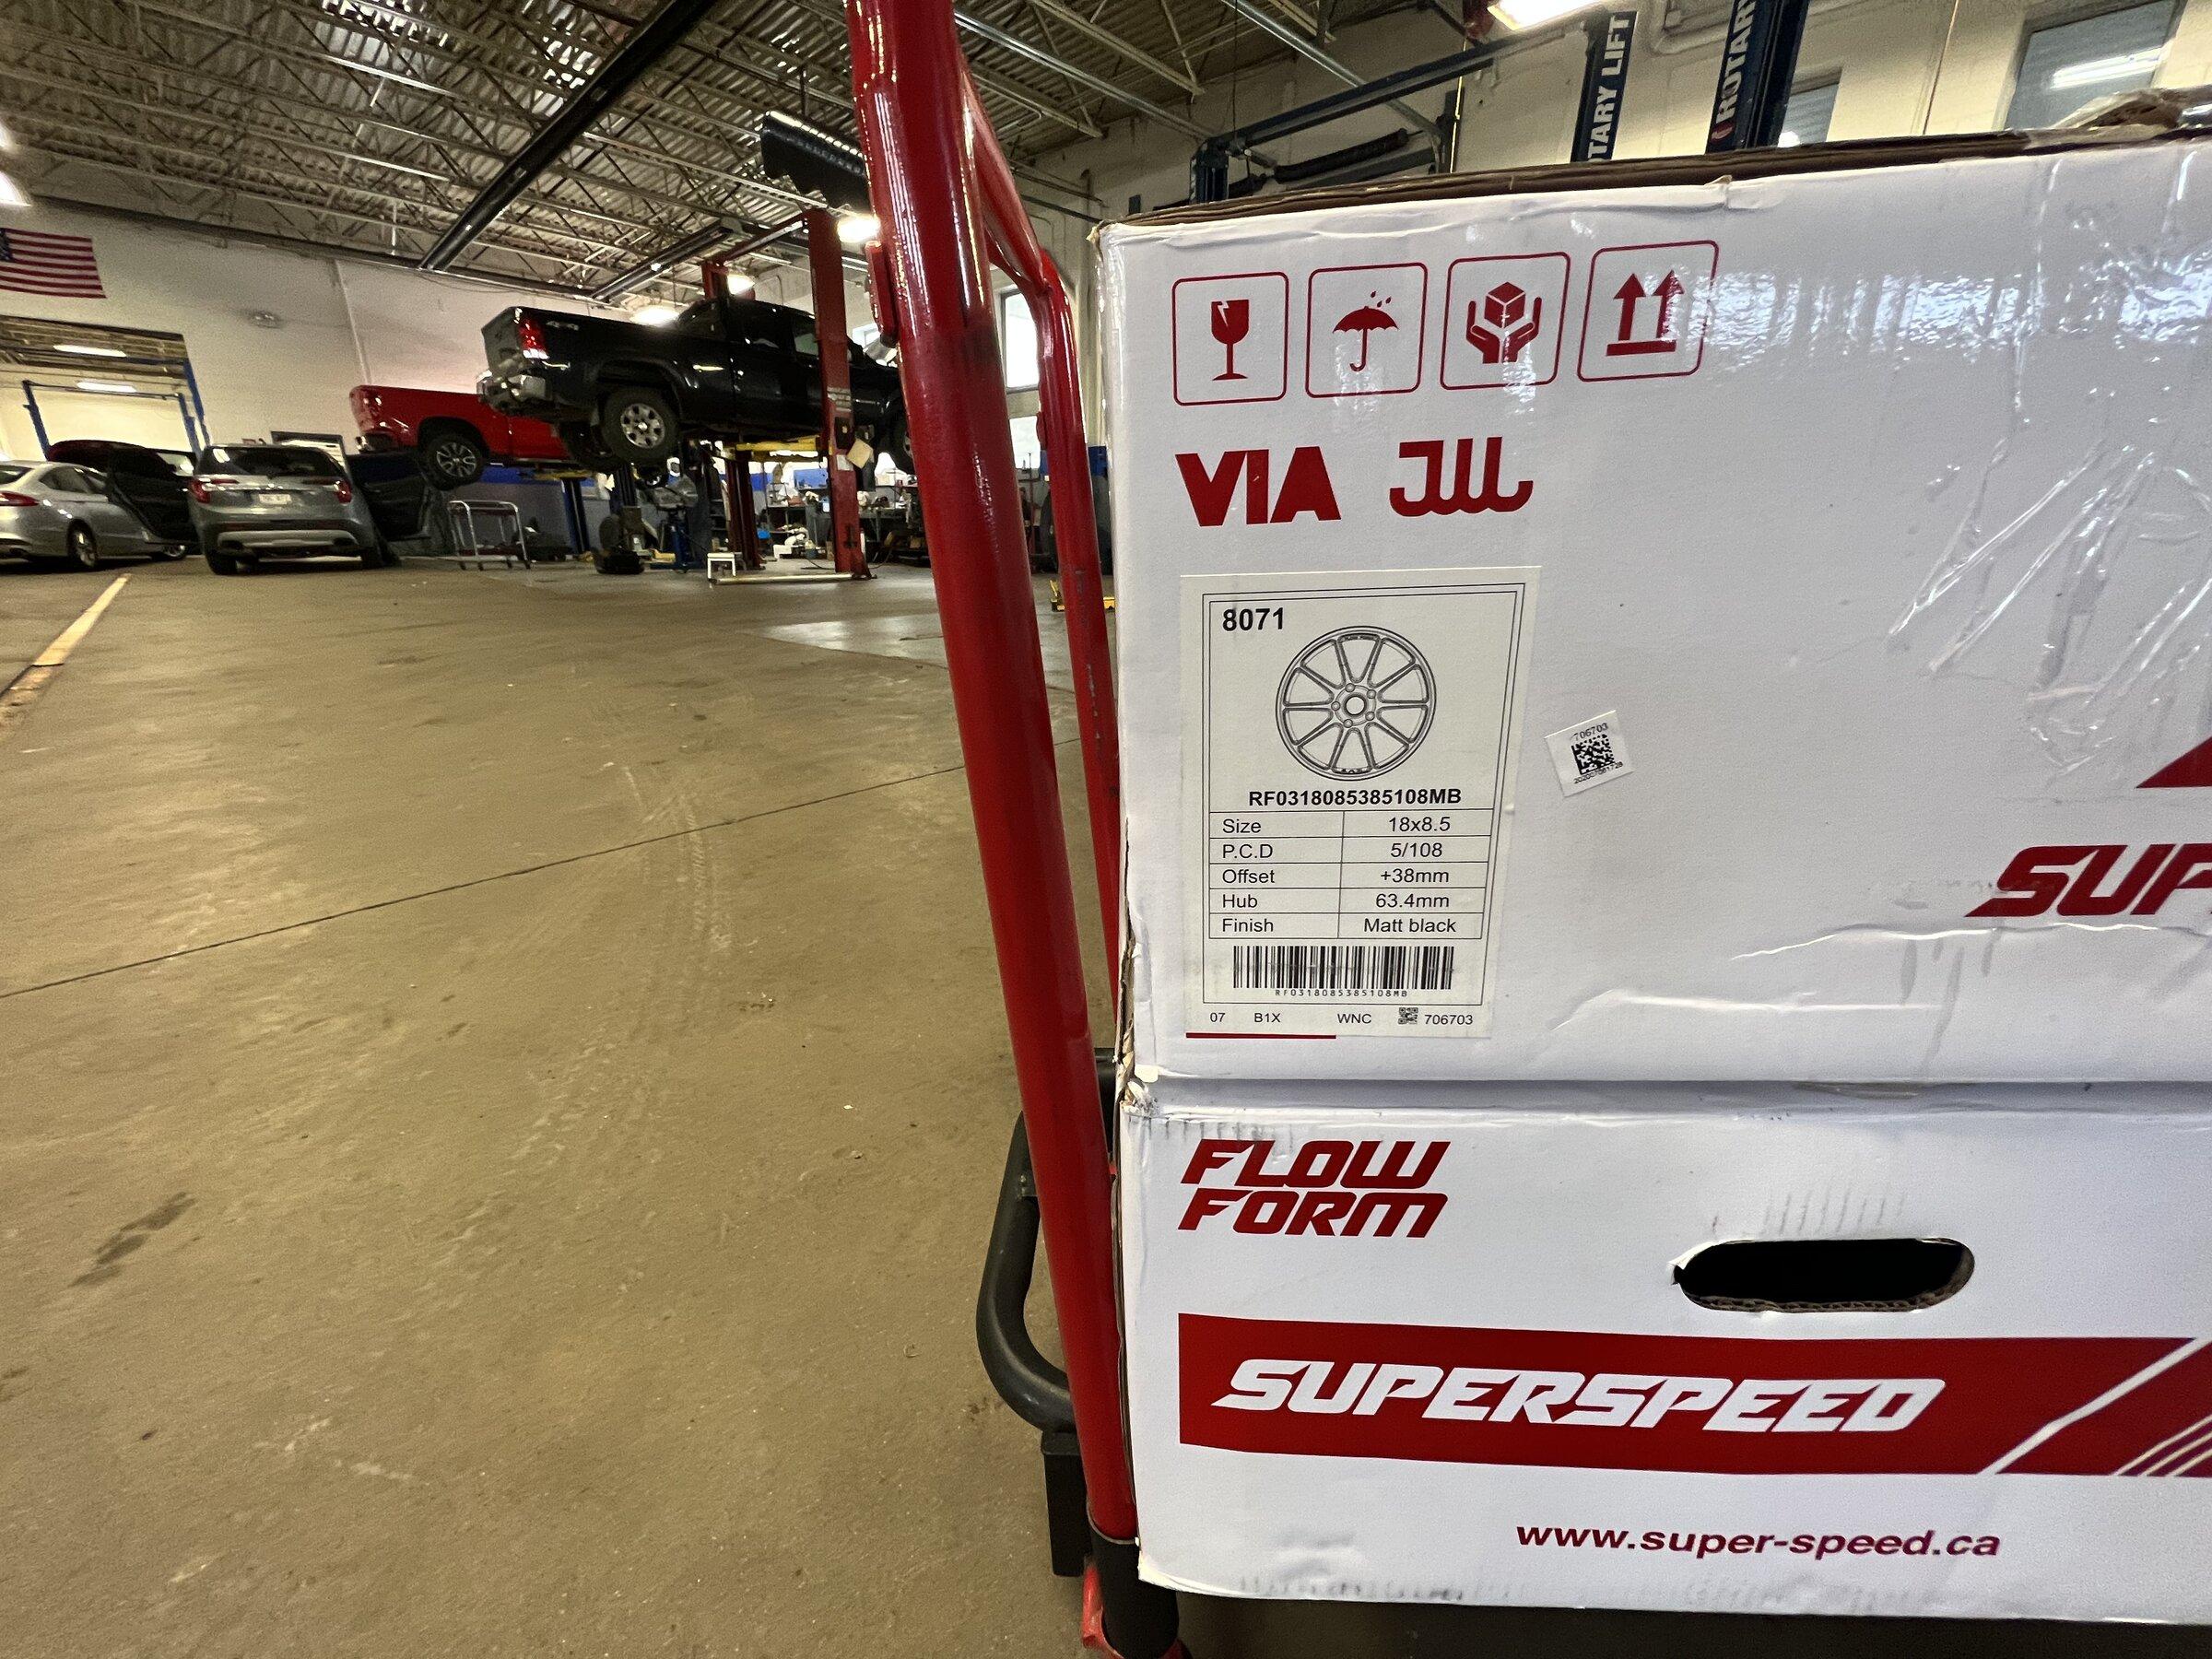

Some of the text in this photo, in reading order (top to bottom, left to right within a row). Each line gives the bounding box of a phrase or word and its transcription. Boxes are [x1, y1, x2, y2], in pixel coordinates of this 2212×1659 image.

[1587, 16, 1629, 162] TARY LIFT
[1175, 446, 1342, 526] VIA
[1222, 607, 1284, 631] 8071
[1571, 723, 1608, 741] 706703
[1248, 788, 1462, 807] RF0318085385108MB
[1222, 817, 1451, 833] Size 18x8.5
[1222, 842, 1443, 859] P.C.D 5/108
[1222, 868, 1450, 884] Offset +38mm
[1964, 842, 2212, 917] SUP
[1222, 894, 1450, 908] Hub 63.4mm
[1222, 918, 1456, 933] Finish Matt black
[1275, 989, 1407, 998] RF0318085385108MB
[1209, 1012, 1474, 1026] 07 B1X WNC 706703
[1180, 1138, 1452, 1189] FLOW
[1177, 1188, 1449, 1238] FORM
[1210, 1359, 1946, 1432] SUPERSPEED
[1516, 1525, 2001, 1560] www.super-speed.ca
